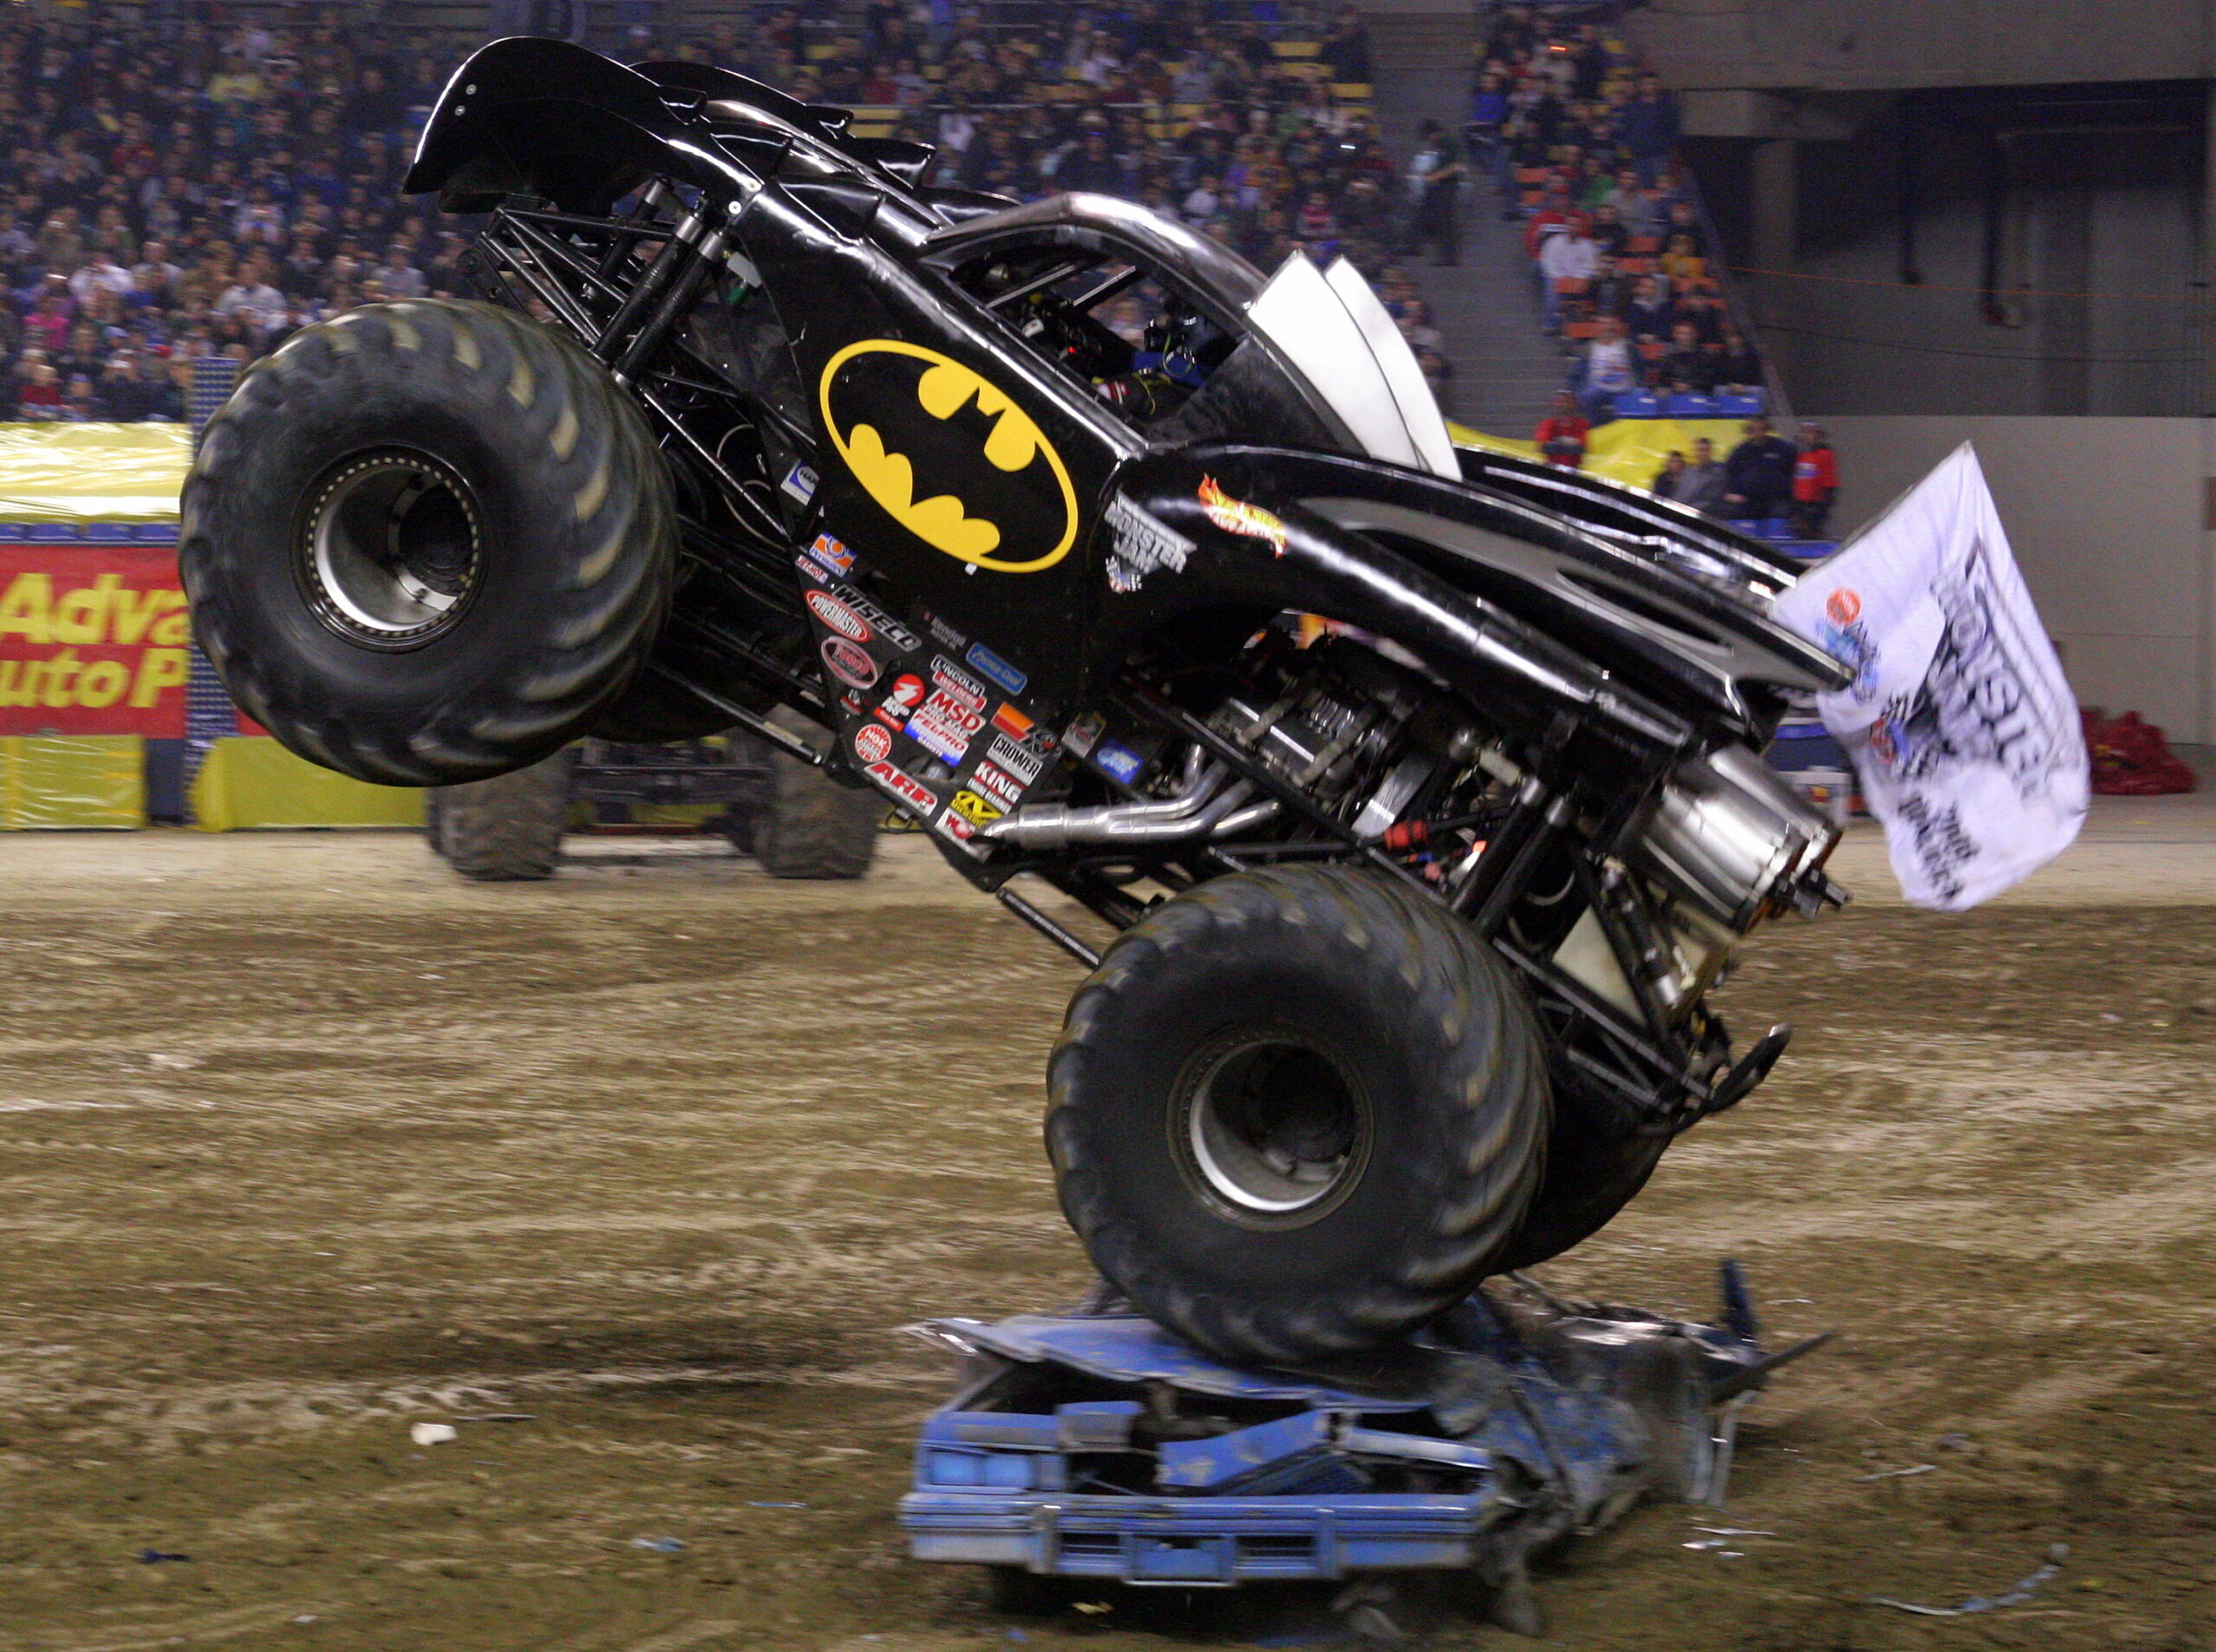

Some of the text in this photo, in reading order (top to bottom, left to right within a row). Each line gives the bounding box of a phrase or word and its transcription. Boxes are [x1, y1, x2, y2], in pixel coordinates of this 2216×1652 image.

[0, 573, 190, 645] Adva
[810, 595, 864, 639] POWERMASTER
[833, 586, 918, 648] WISECO
[0, 647, 191, 709] uto P
[935, 659, 981, 697] LINCOLN
[939, 675, 978, 707] WELDERS
[930, 692, 982, 730] MSD
[992, 736, 1041, 777] CROWER
[869, 761, 936, 806] ARP
[975, 761, 1022, 804] KING
